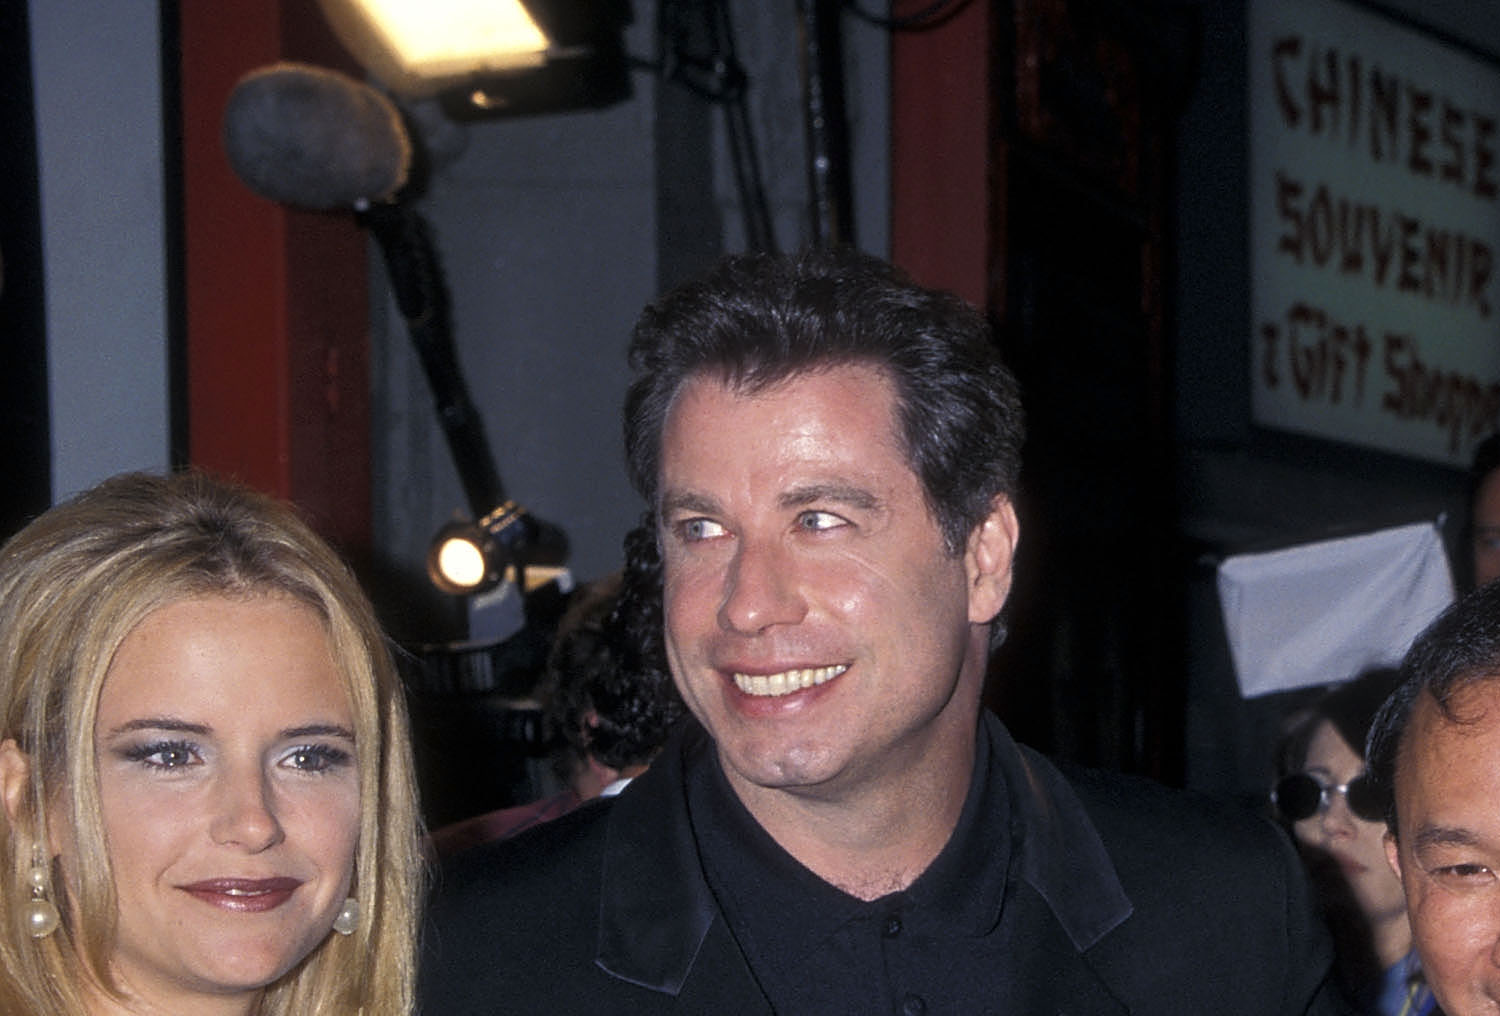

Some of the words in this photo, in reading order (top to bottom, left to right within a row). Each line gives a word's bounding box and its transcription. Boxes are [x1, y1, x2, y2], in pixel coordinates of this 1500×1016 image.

[1272, 36, 1498, 199] CHINESE
[1276, 171, 1493, 319] SOUVENIR
[1288, 302, 1371, 406] Gift
